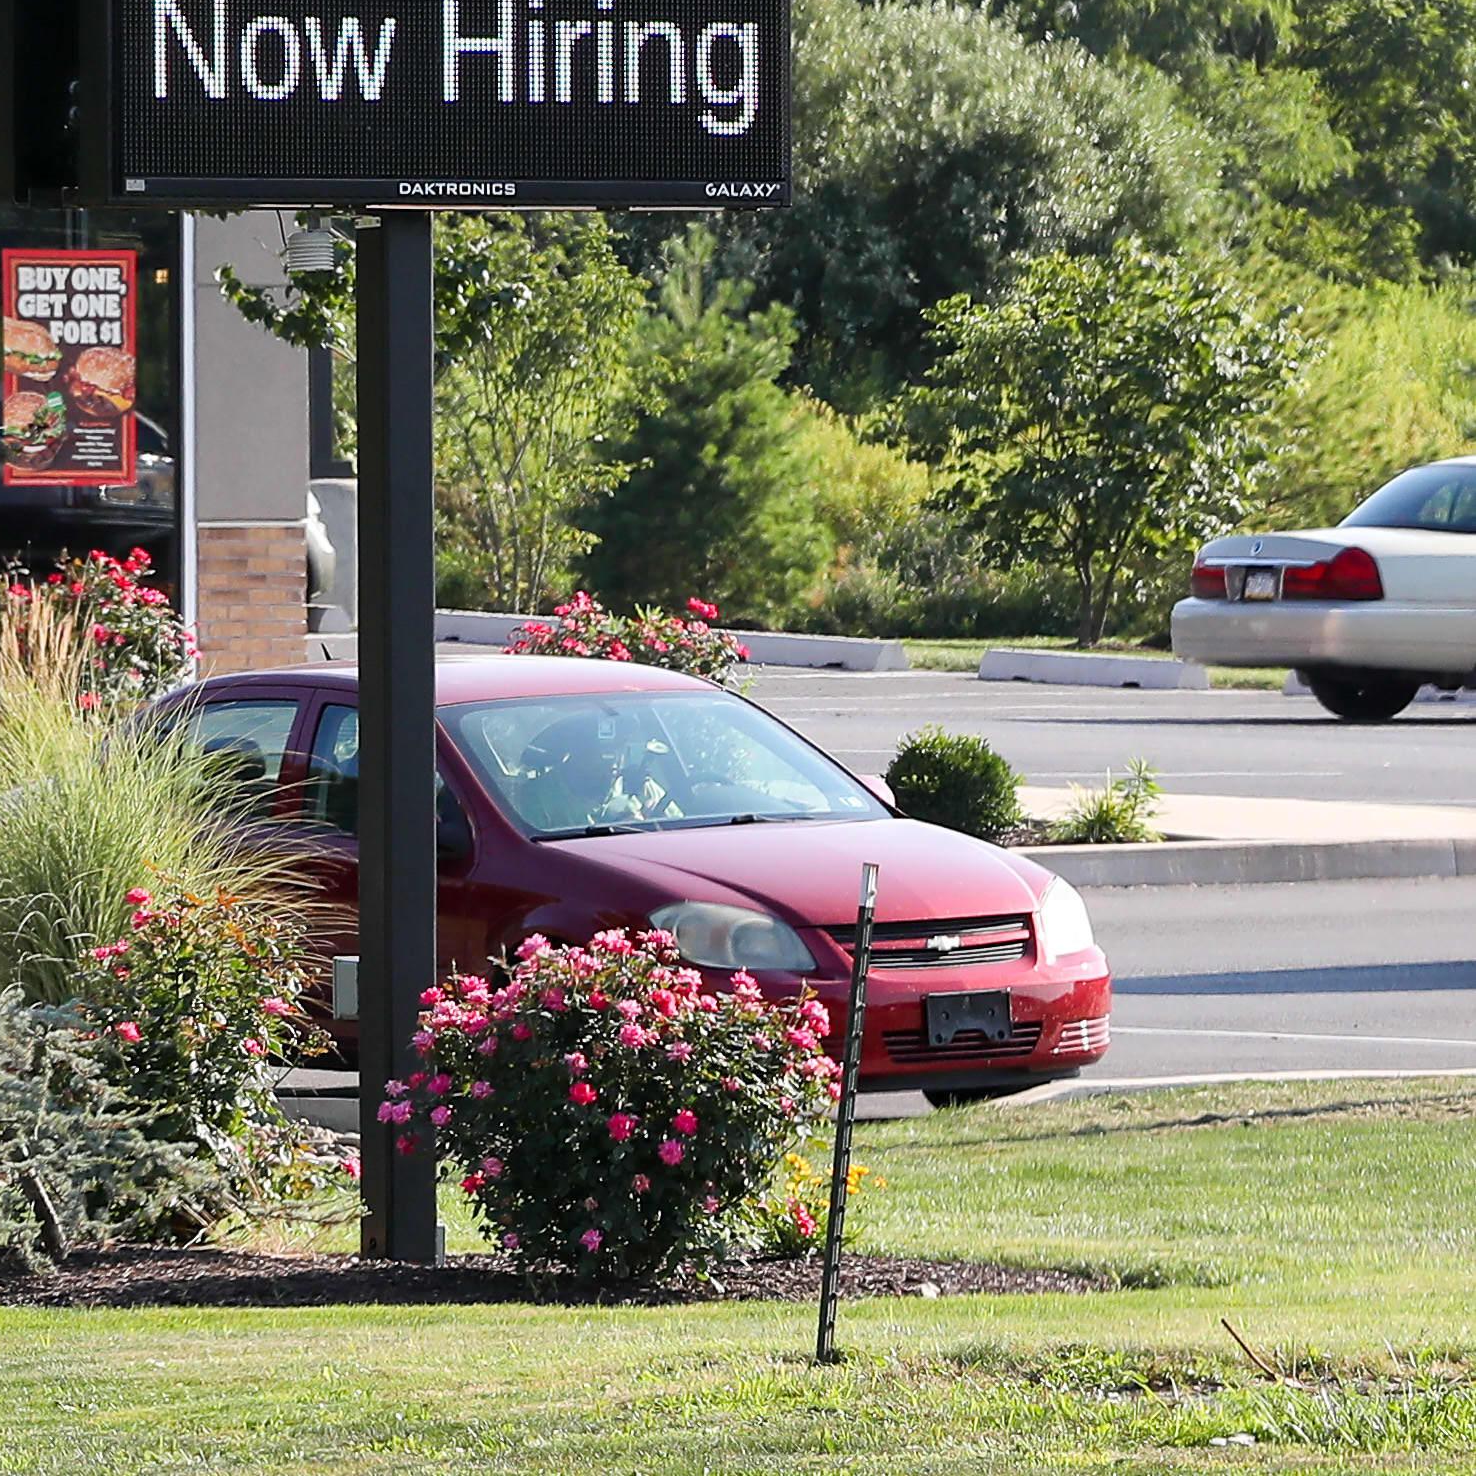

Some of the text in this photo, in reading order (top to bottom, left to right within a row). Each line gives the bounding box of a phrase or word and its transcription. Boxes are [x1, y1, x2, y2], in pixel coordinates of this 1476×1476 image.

[398, 181, 517, 196] DAKTRONICS
[704, 182, 777, 197] GALAXY
[17, 266, 128, 295] BUY ONE,
[17, 293, 122, 319] GET ONE
[49, 320, 123, 344] FOR $1
